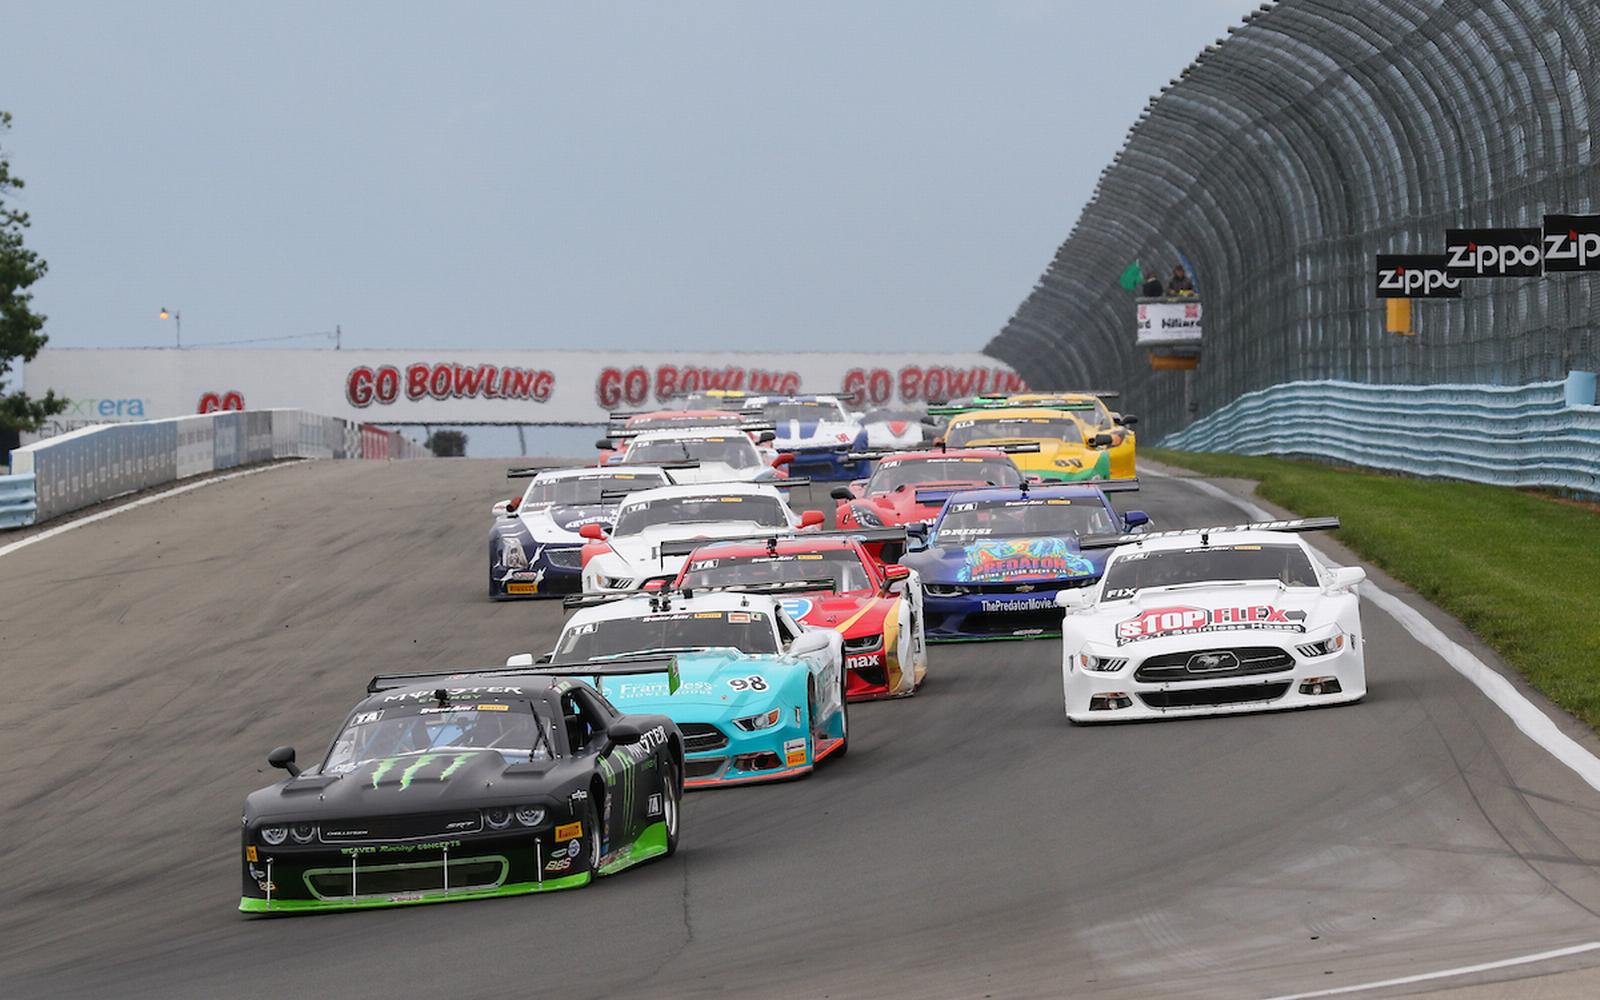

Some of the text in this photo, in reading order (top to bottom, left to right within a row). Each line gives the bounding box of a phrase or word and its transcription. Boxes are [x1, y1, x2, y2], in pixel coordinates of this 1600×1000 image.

[347, 361, 555, 408] GO BOWLING
[597, 366, 652, 411] GO
[843, 366, 895, 408] GO
[940, 528, 992, 536] DRISSI
[972, 555, 1067, 576] PREDATOR
[1107, 588, 1137, 598] FIX
[1119, 605, 1289, 638] STOP FLEX
[620, 680, 713, 695] Framless
[728, 675, 769, 693] 98
[383, 686, 523, 702] MOSTER
[419, 694, 482, 703] ENRGY
[446, 821, 475, 830] SRT
[340, 839, 462, 855] WEAVER Racing CONCEPTS
